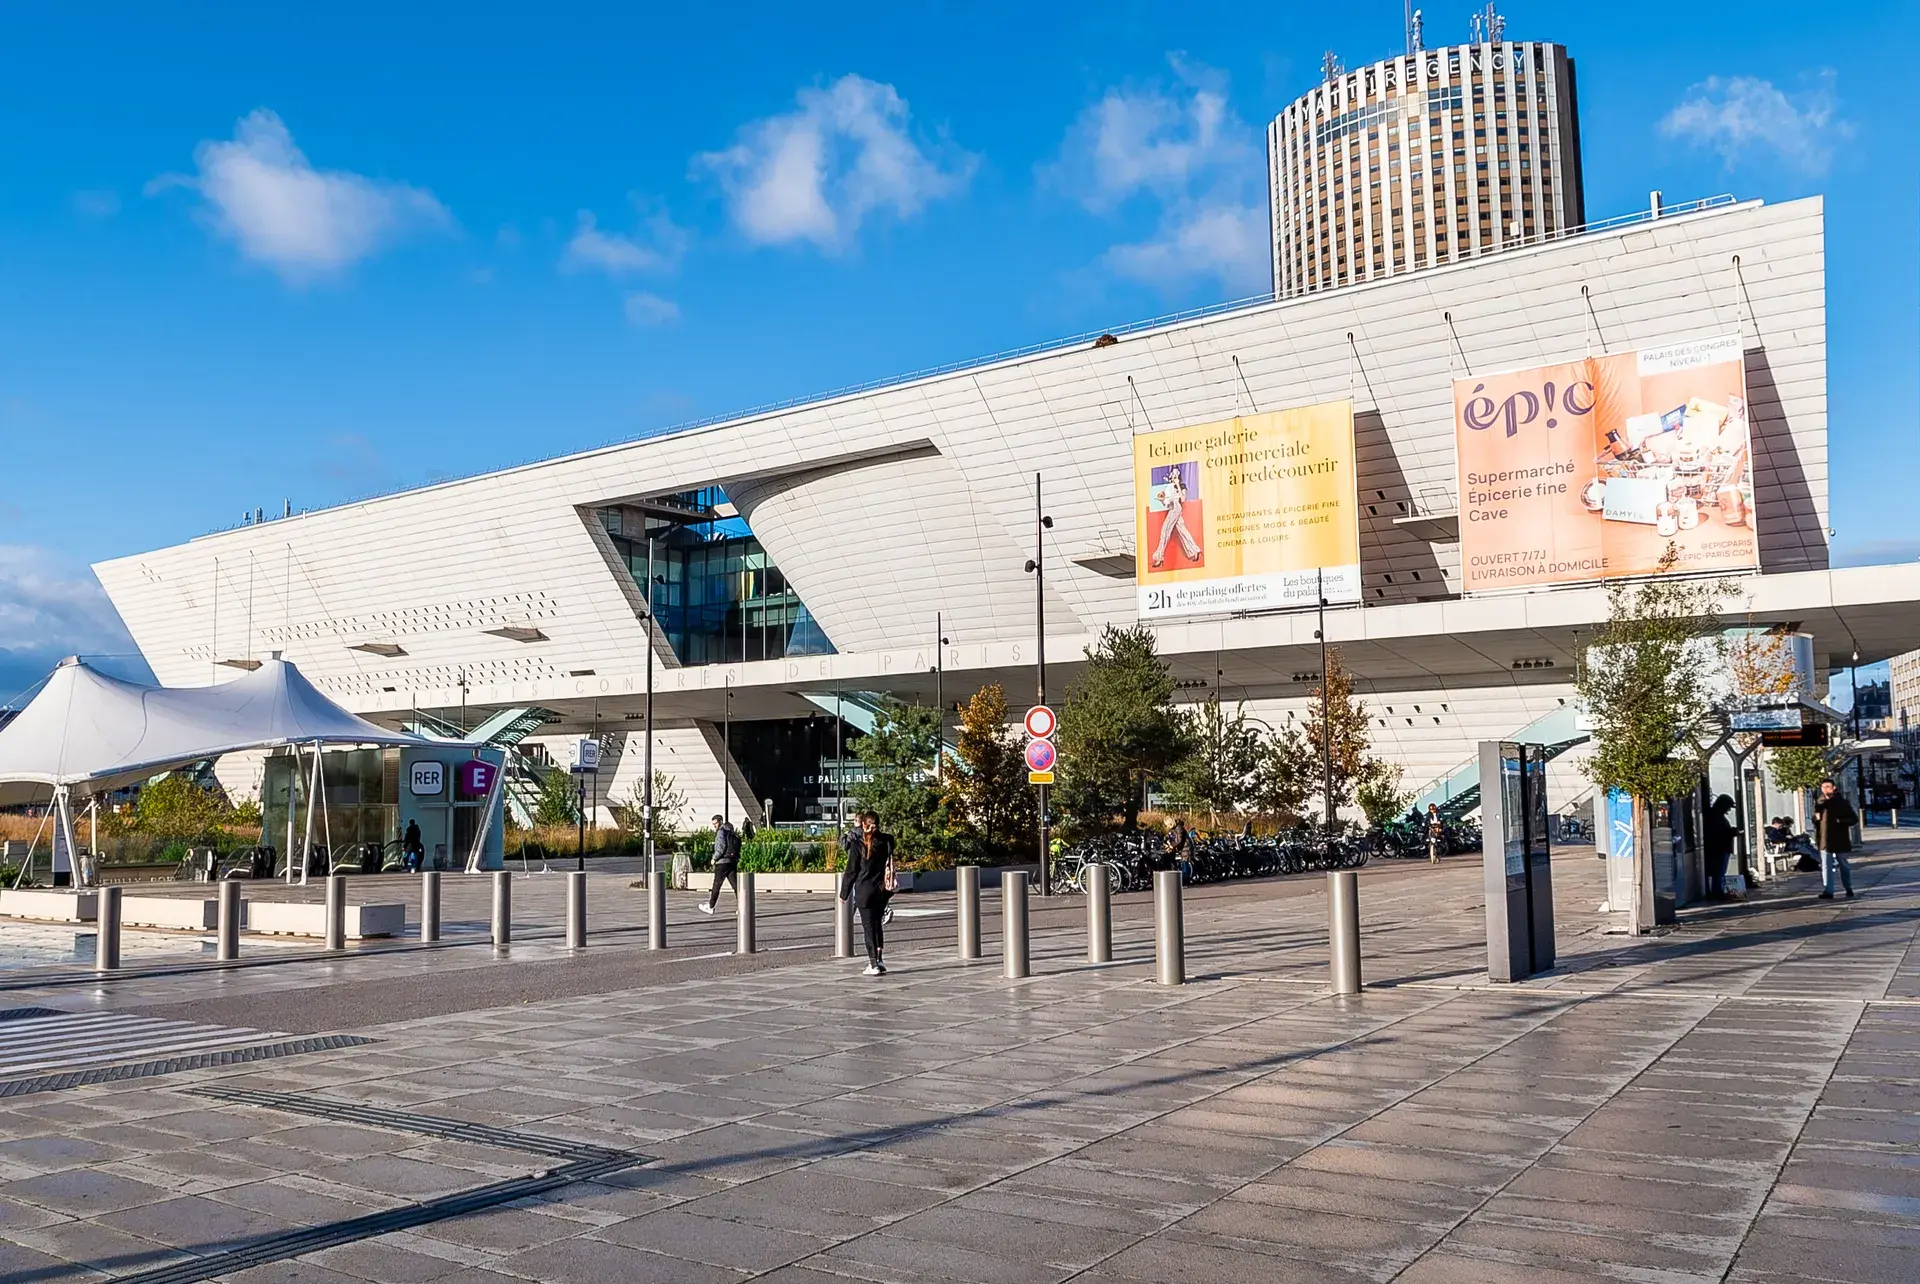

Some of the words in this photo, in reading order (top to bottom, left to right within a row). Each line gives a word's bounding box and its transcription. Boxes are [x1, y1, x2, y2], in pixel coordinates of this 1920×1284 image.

[1290, 82, 1357, 129] HYATT
[1385, 53, 1525, 87] REGENCY
[1643, 351, 1673, 361] PALAIS
[1675, 347, 1692, 356] DES
[1670, 355, 1701, 367] NIVEAU
[1149, 442, 1171, 458] Ici,
[1175, 441, 1202, 454] une
[1205, 428, 1258, 451] galerie
[1206, 440, 1310, 469] commerciale
[1229, 474, 1237, 486] à
[1241, 457, 1339, 485] redécouvrir
[1467, 459, 1575, 486] Supermarché
[1468, 486, 1533, 506] Épicerie
[1536, 482, 1568, 497] fine
[1216, 509, 1273, 522] RESTAURANTS
[1322, 500, 1341, 509] FINE
[1469, 509, 1509, 522] Cave
[1216, 523, 1261, 535] ENSEIGNES
[1263, 520, 1288, 529] MODE
[1298, 515, 1330, 526] BEAUTÉ
[1258, 534, 1289, 544] LOISIRS
[1471, 552, 1519, 567] OUVERT
[1521, 549, 1546, 561] 7/7J
[1471, 565, 1535, 581] LIVRAISON
[1538, 562, 1546, 574] À
[1549, 557, 1609, 573] DOMICILE
[1283, 577, 1299, 587] Les
[1300, 574, 1344, 585] bouques
[1148, 589, 1172, 610] 2h
[1176, 589, 1188, 599] de
[1190, 586, 1227, 600] parking
[1228, 583, 1267, 594] offertes
[1283, 587, 1295, 598] du
[1297, 585, 1321, 599] palai
[360, 691, 450, 709] PALIS
[789, 661, 827, 679] DE
[883, 646, 1021, 671] PARIS
[414, 771, 440, 785] RER
[473, 768, 486, 787] E
[803, 775, 814, 784] LE
